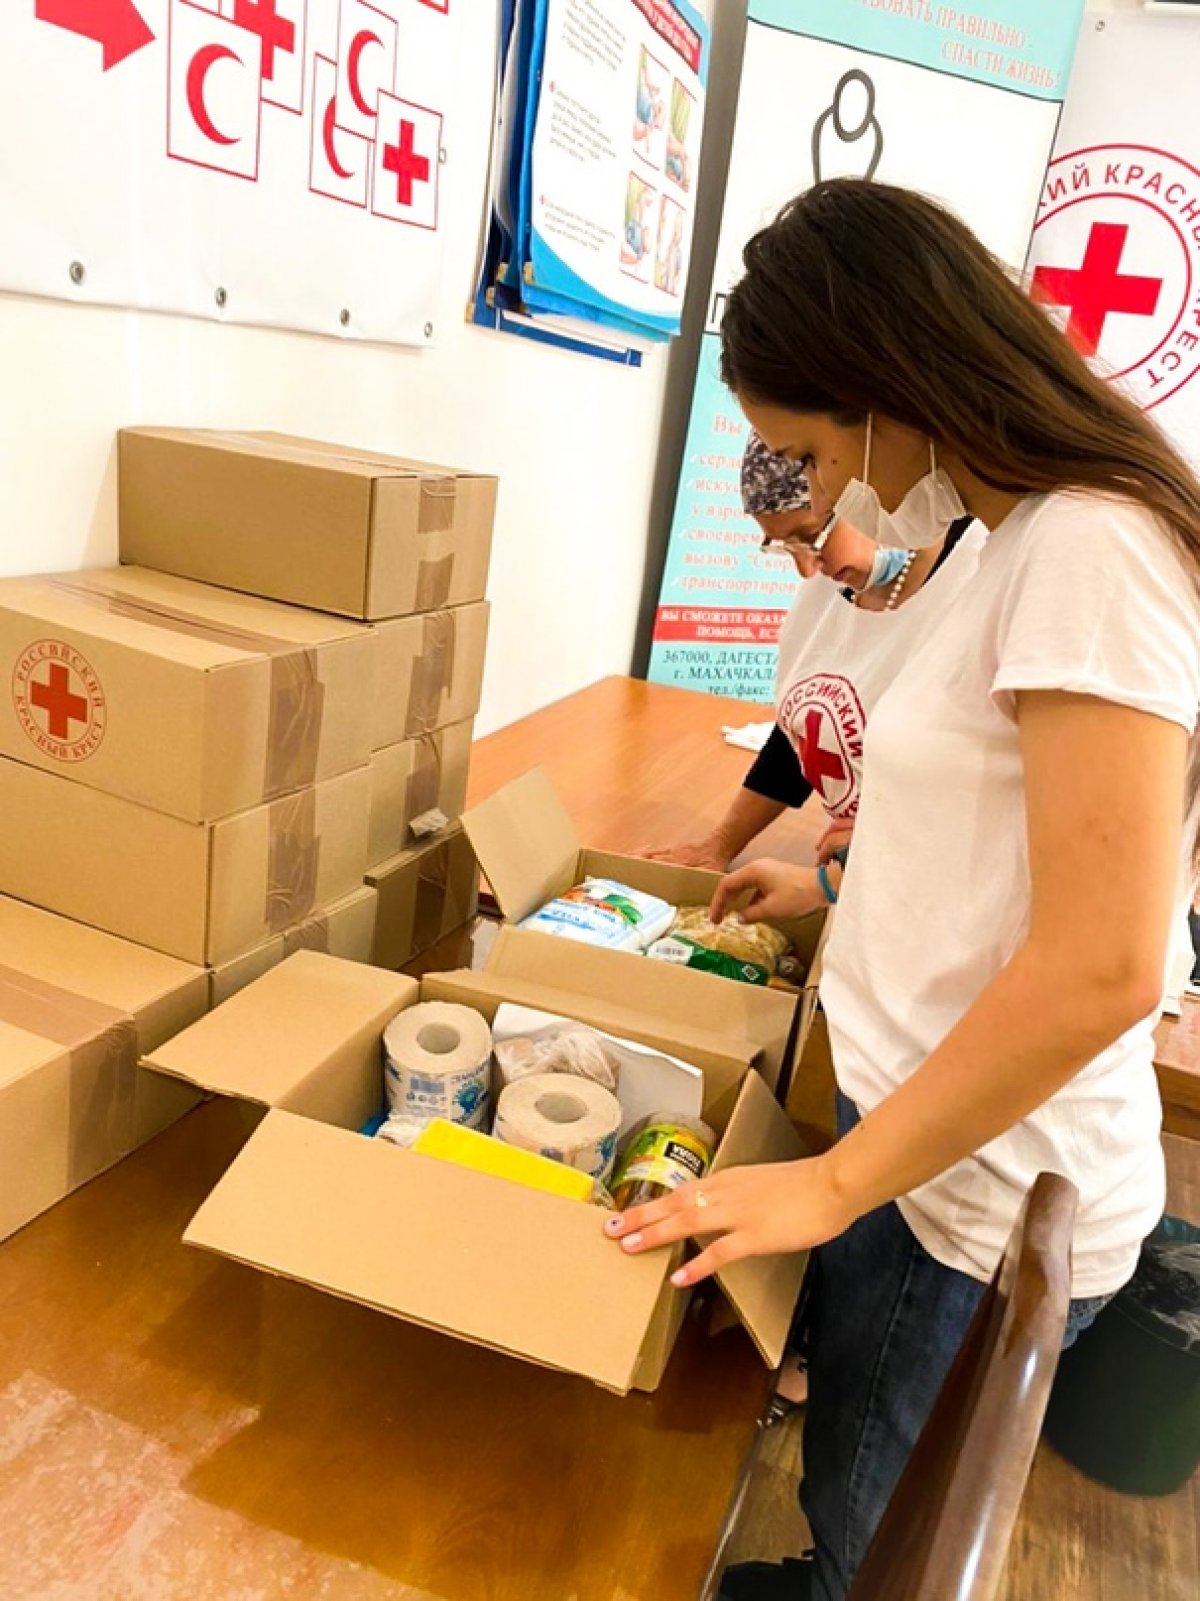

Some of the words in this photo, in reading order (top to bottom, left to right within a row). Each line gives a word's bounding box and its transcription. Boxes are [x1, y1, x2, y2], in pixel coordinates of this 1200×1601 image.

[942, 40, 1003, 75] СПАСТИ
[1039, 162, 1092, 208] ИЙ
[1147, 287, 1200, 389] ЕСТ
[714, 415, 742, 434] Вы
[662, 650, 713, 665] 367000,
[17, 644, 103, 707] РОССИЙСКИЙ
[688, 667, 777, 681] МАХАЧКАЛ
